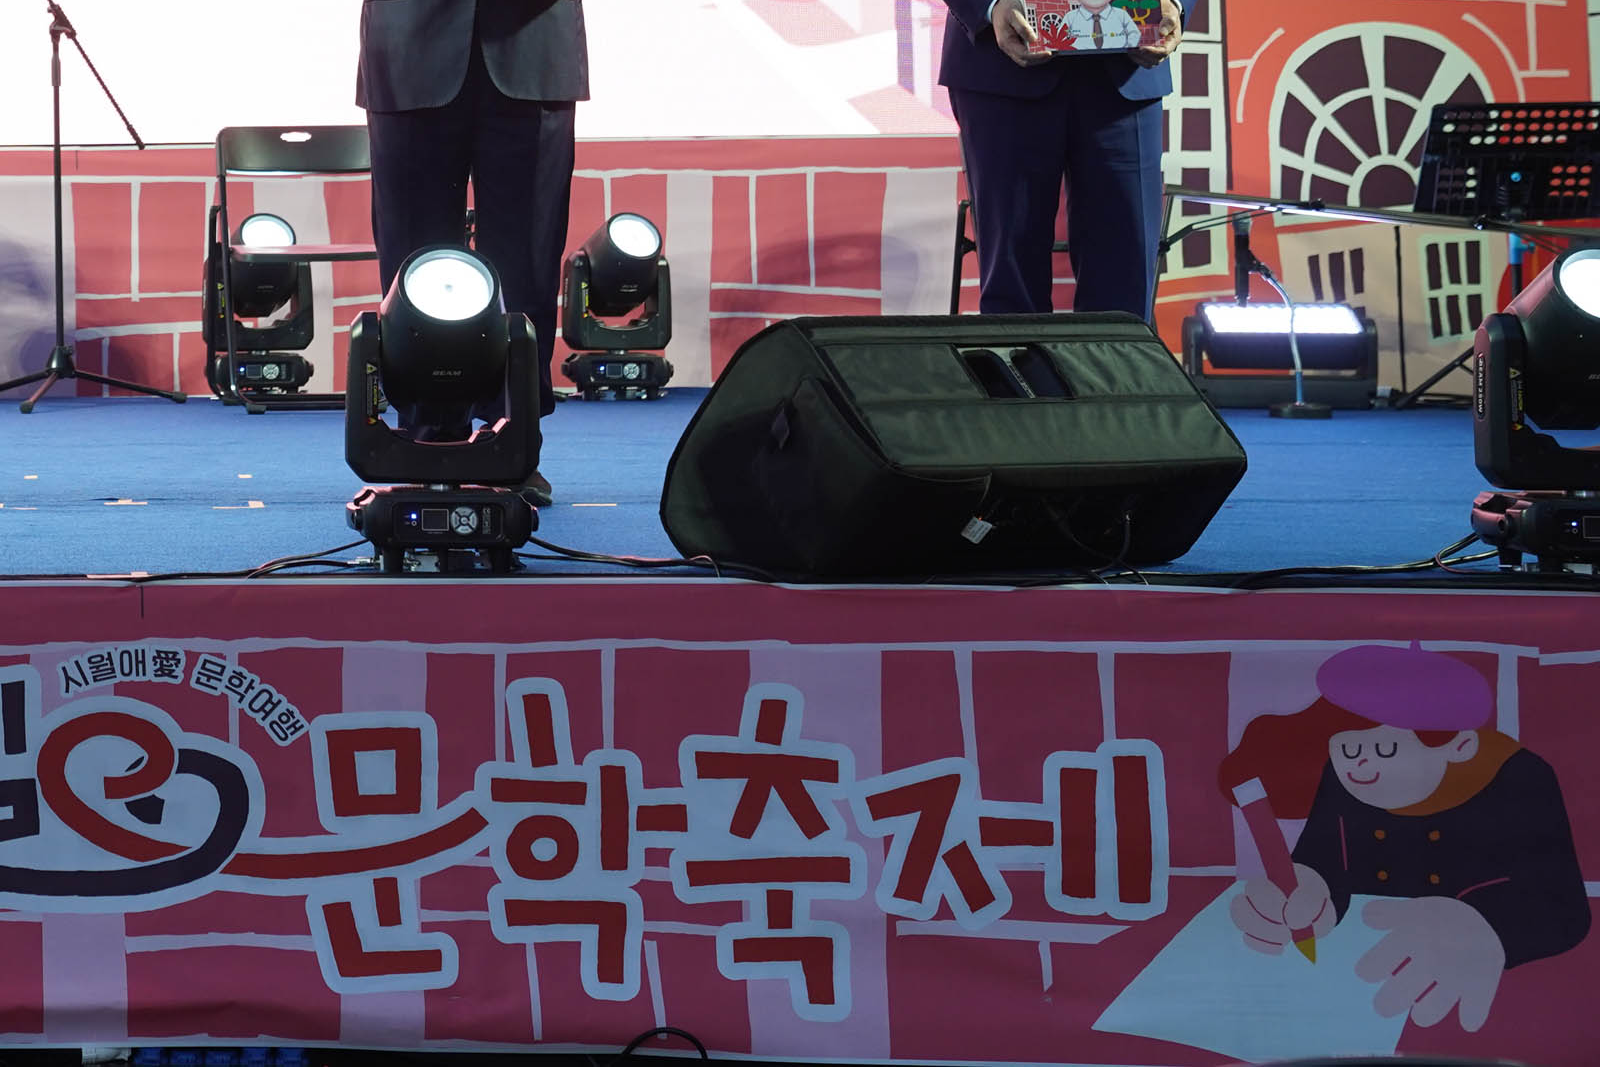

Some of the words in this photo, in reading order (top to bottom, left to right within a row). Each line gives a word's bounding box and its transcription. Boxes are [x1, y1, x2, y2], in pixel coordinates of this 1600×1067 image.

[60, 648, 182, 694] 시월애愛
[194, 657, 305, 742] 문학여행
[220, 691, 1154, 1006] 문학축제
